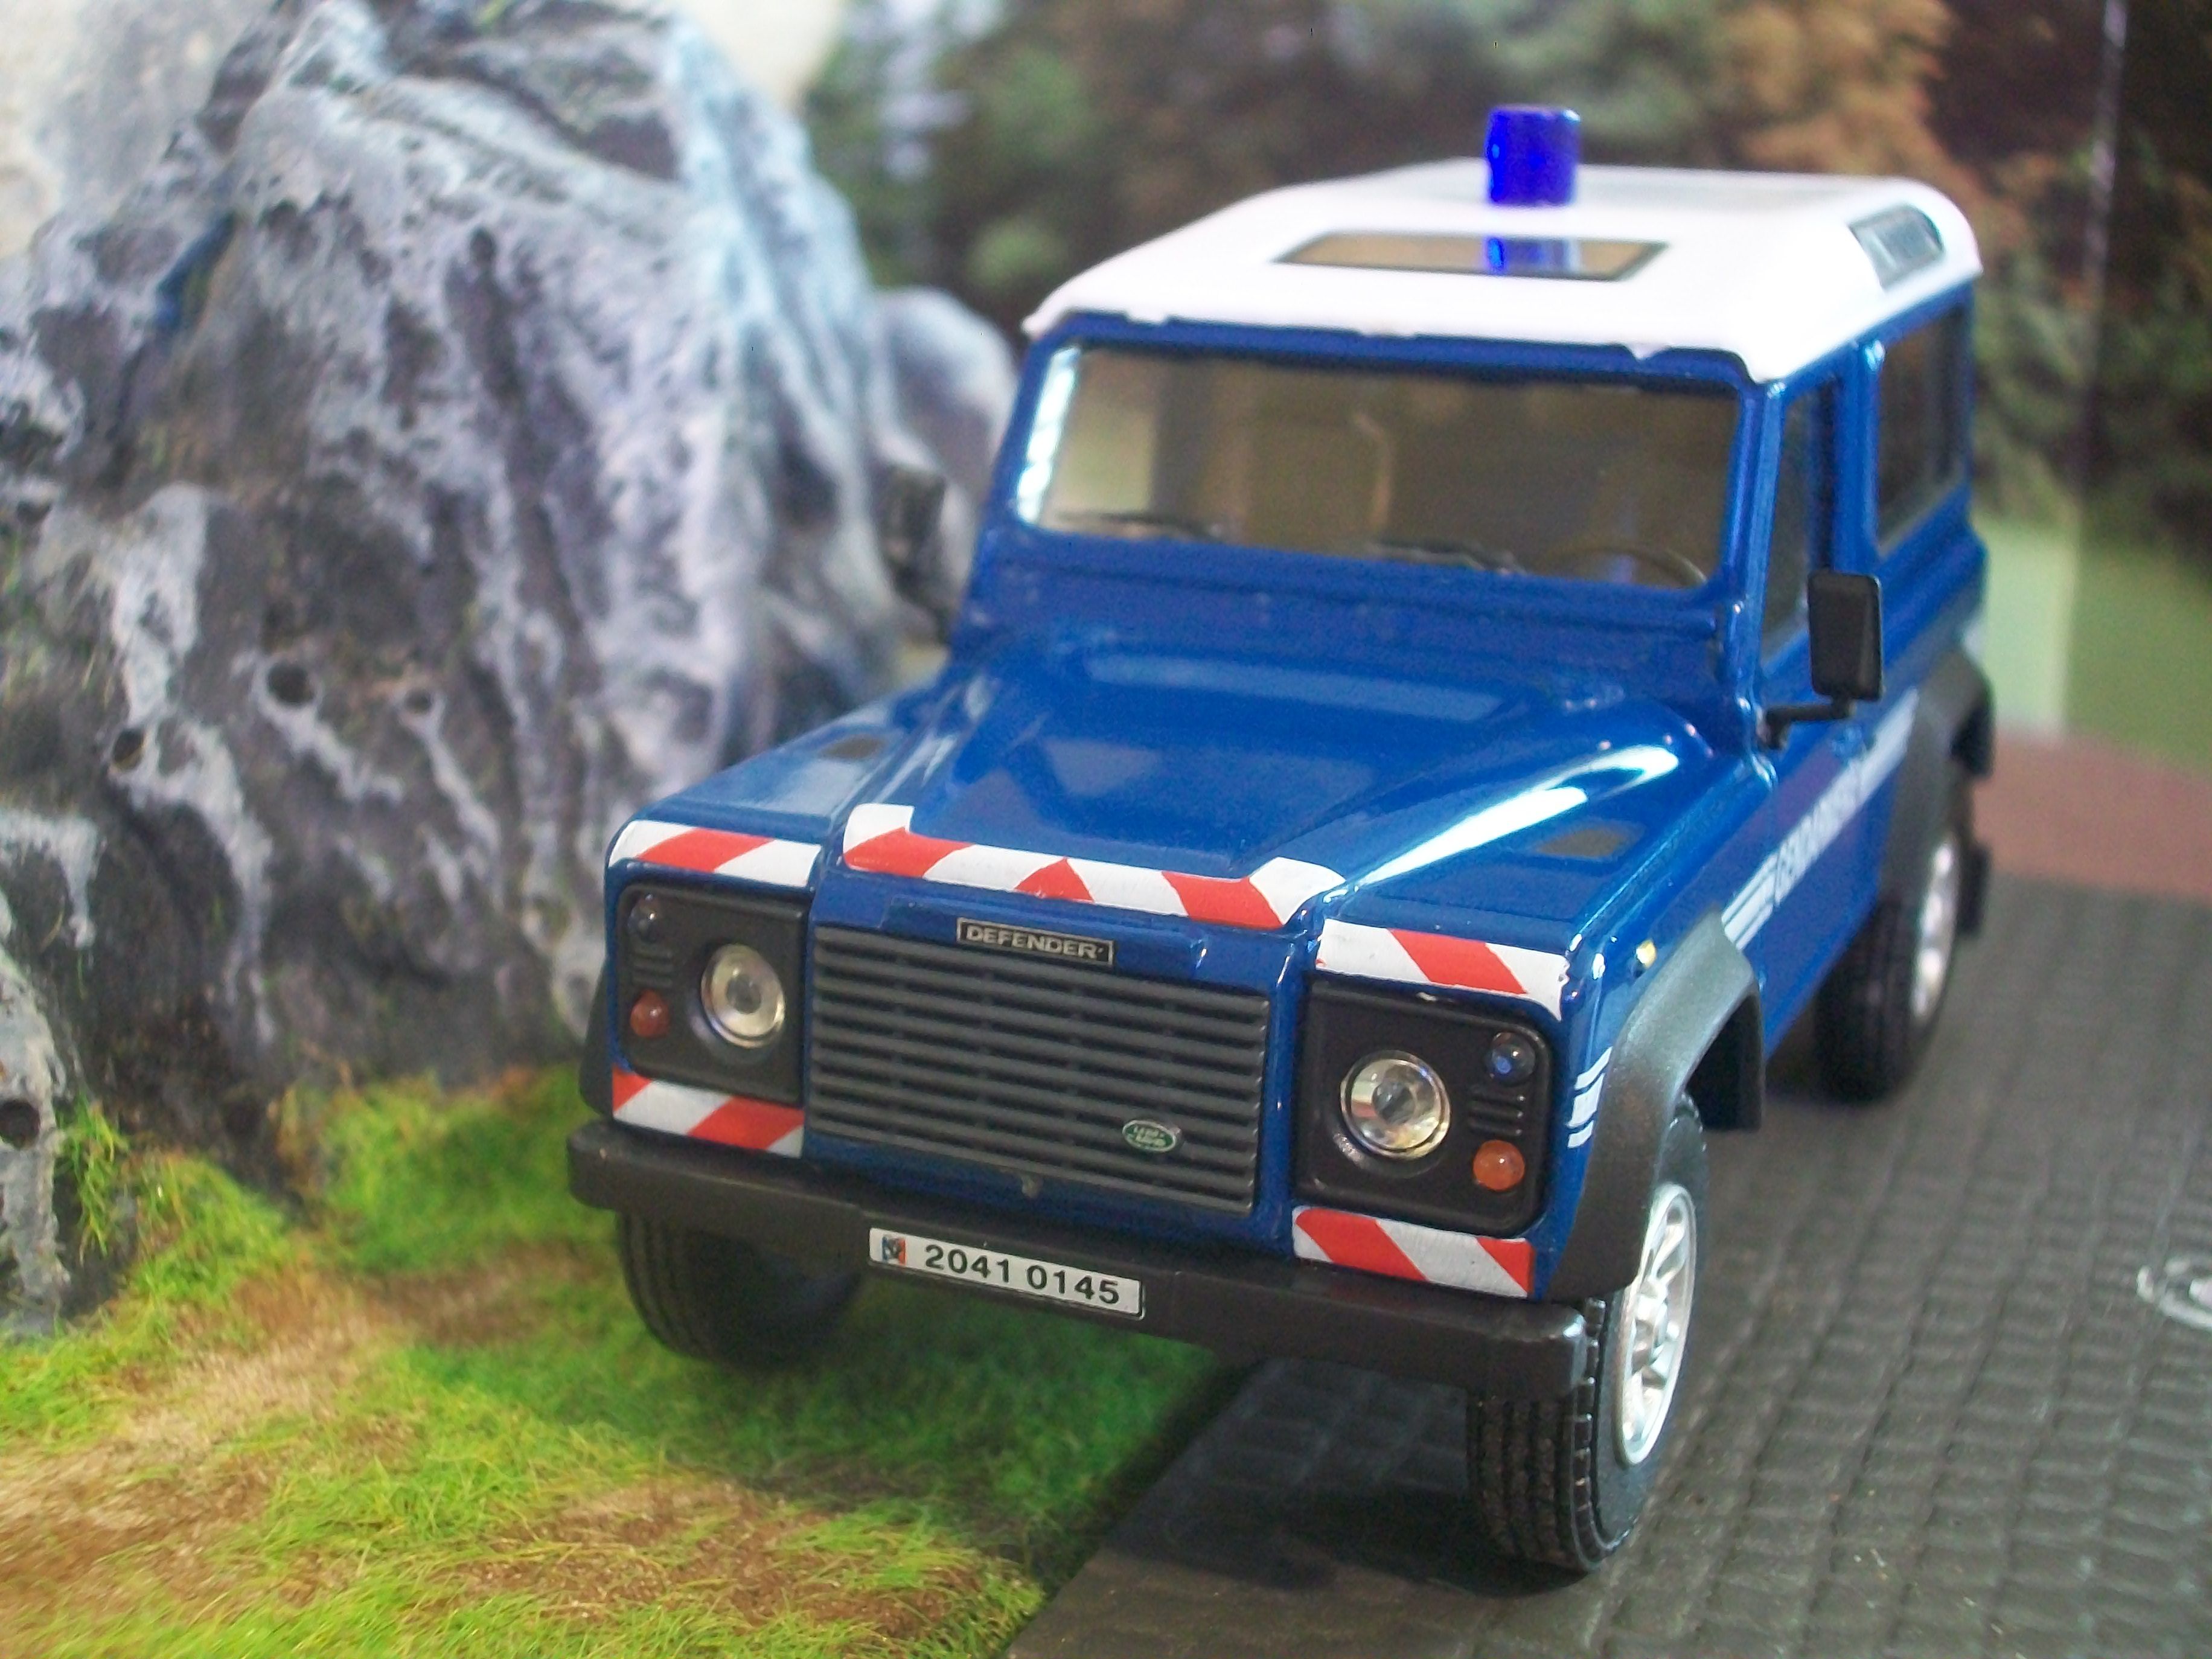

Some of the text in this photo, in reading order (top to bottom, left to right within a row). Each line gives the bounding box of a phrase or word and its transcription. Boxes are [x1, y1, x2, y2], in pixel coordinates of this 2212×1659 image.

[967, 925, 1099, 959] DEFENDER
[925, 1244, 1119, 1304] 2041 0145
